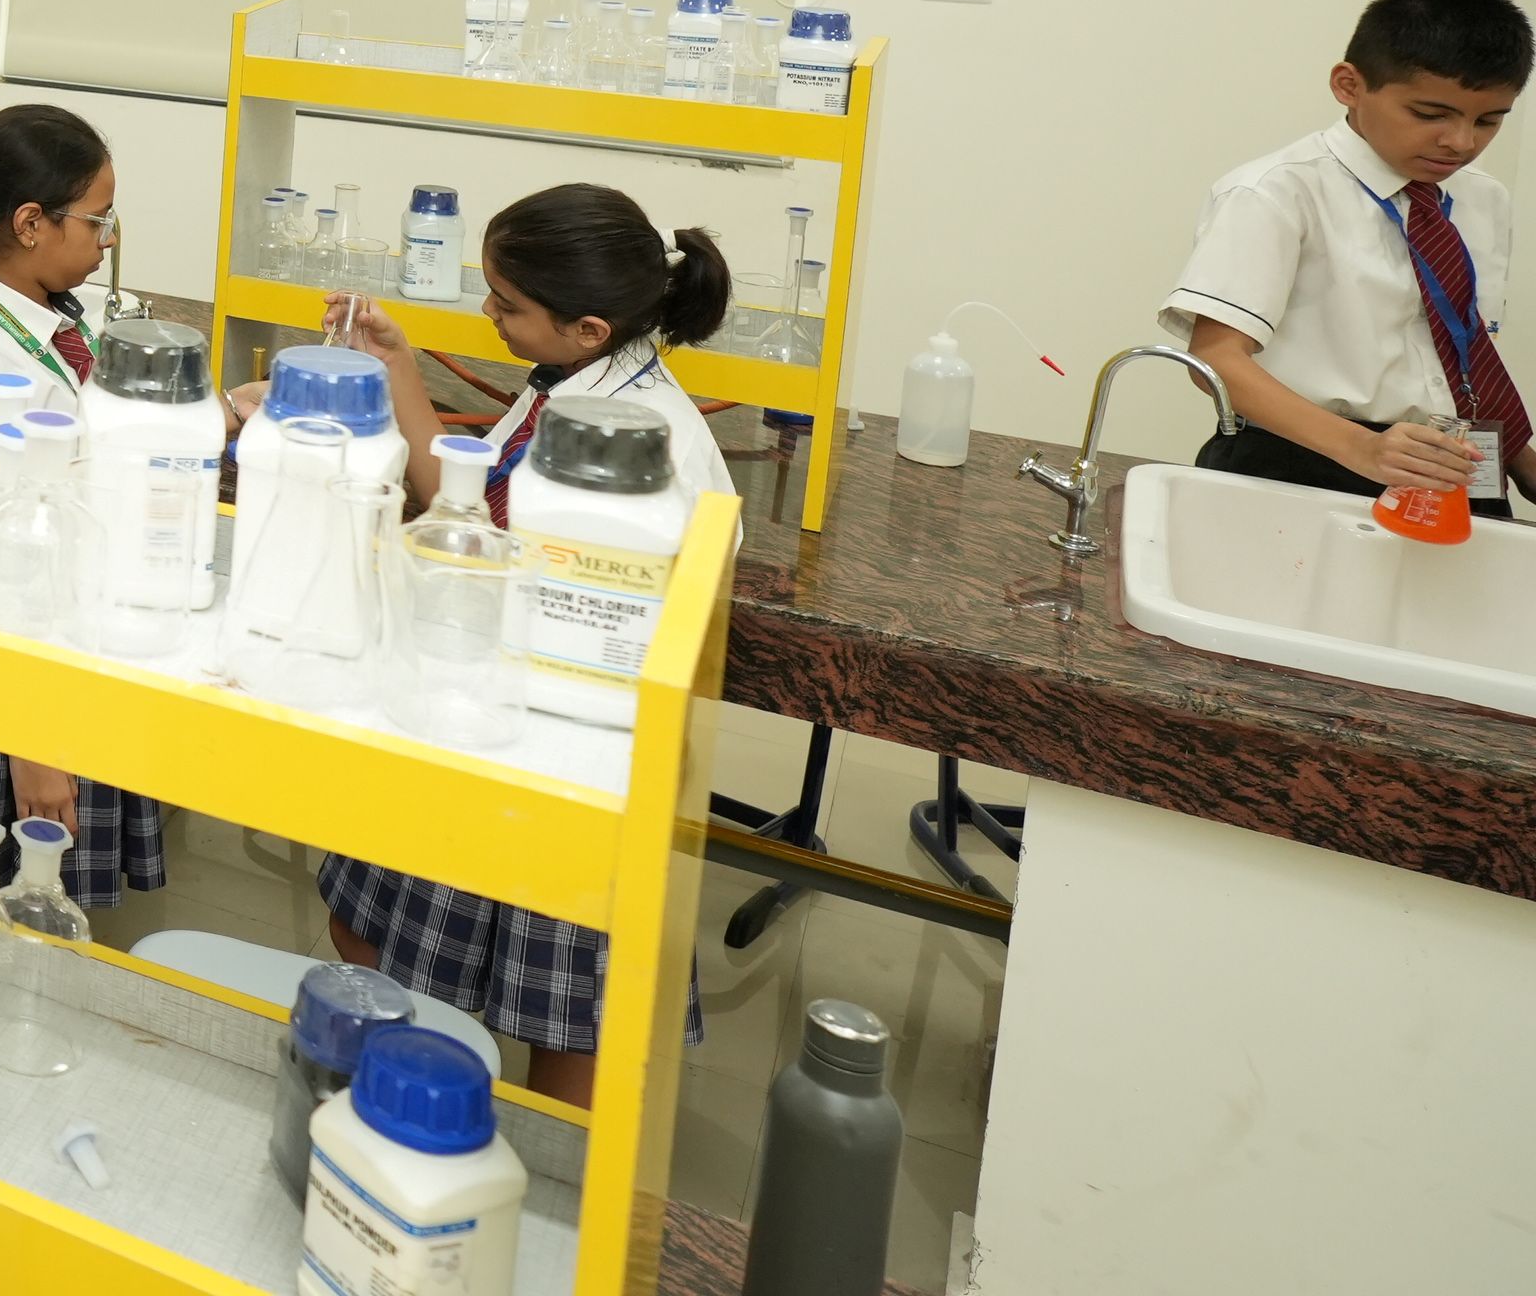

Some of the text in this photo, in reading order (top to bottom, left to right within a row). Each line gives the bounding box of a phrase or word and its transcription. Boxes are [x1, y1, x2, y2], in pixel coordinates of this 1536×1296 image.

[787, 73, 816, 81] POTASSIUM
[573, 552, 654, 581] MERCK
[579, 595, 647, 617] CHLORIDE
